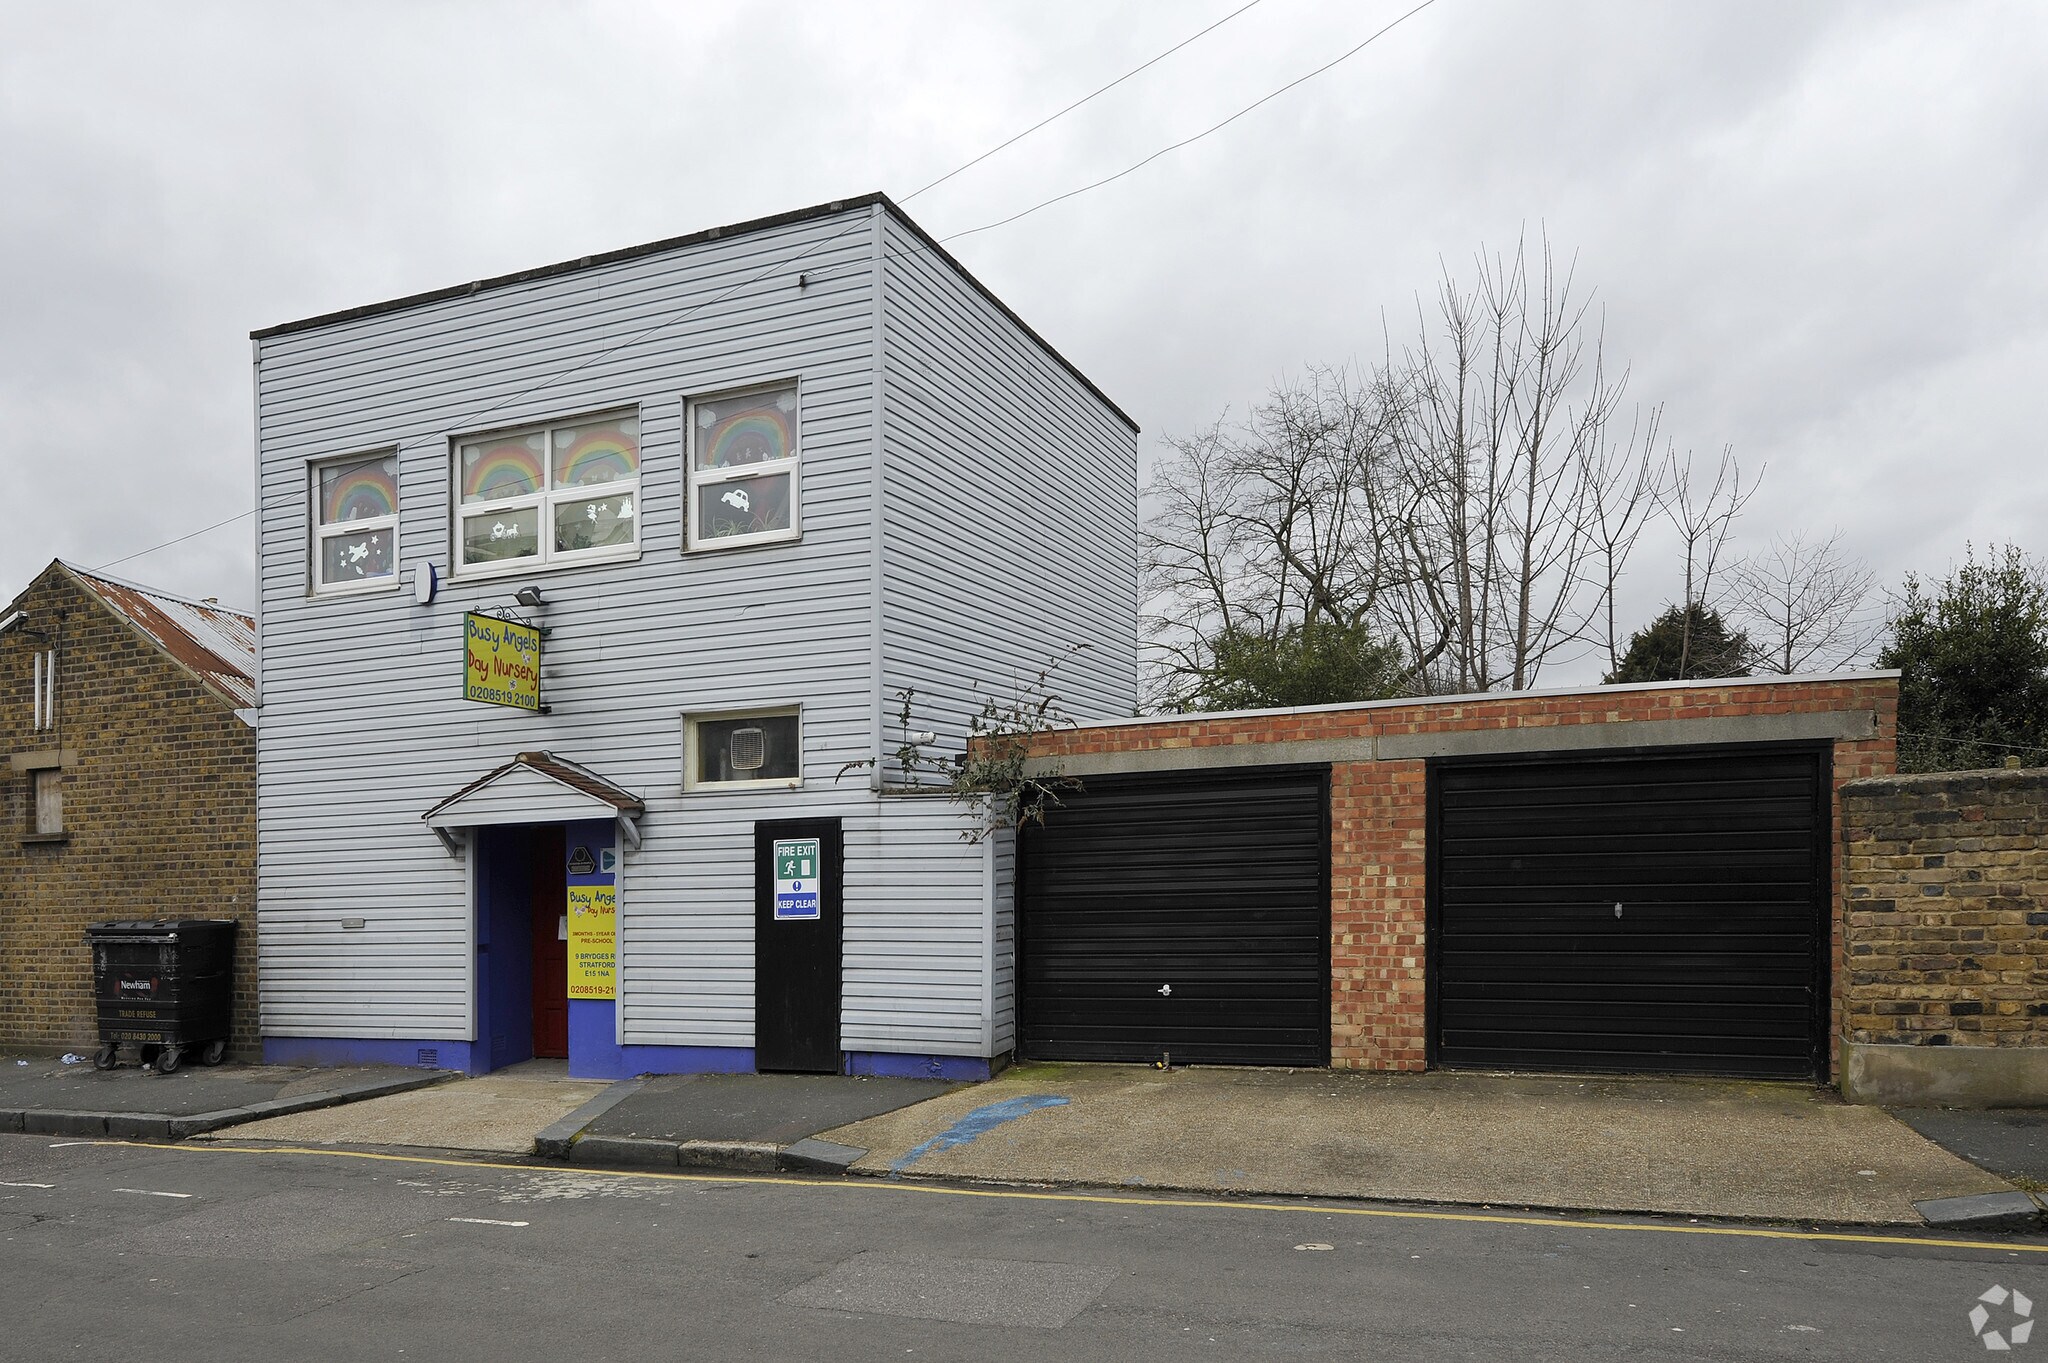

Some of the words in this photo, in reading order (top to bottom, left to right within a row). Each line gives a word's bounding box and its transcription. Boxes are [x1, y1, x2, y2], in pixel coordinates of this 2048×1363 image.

[469, 620, 500, 652] Busy
[503, 625, 537, 652] Angels
[469, 649, 489, 681] Day
[494, 655, 538, 691] Nursery
[470, 685, 512, 703] 0208519
[514, 693, 536, 707] 2100
[778, 846, 795, 857] FIRE
[797, 845, 815, 856] EXIT
[570, 891, 591, 908] Busy
[778, 900, 794, 909] KEEP
[795, 899, 816, 909] CLEAR
[588, 906, 598, 918] Day
[121, 980, 151, 990] Newham
[119, 1010, 135, 1018] TRADE
[137, 1010, 156, 1019] REFUSE
